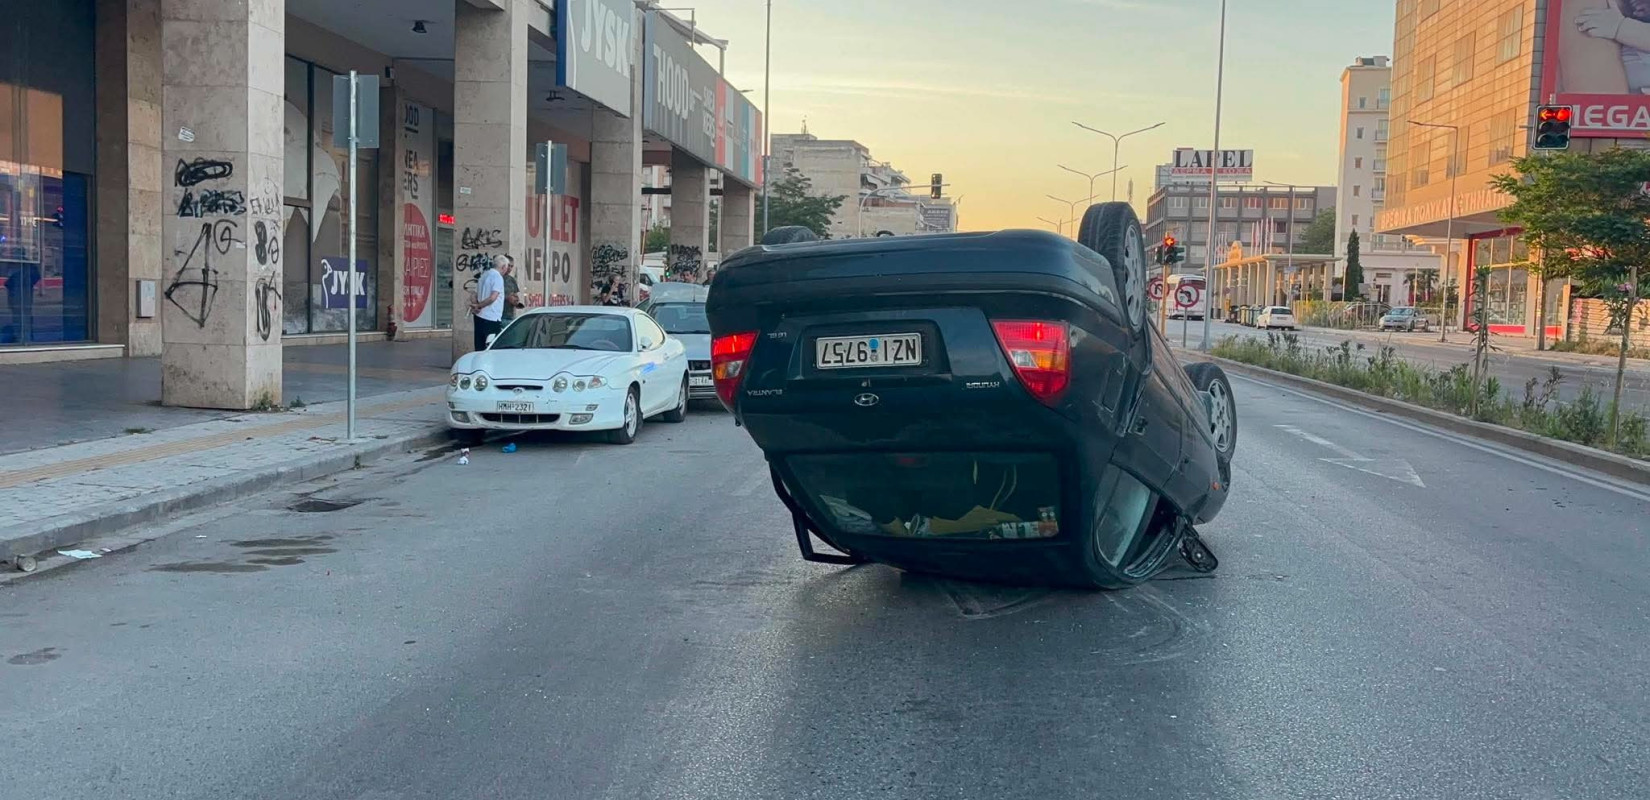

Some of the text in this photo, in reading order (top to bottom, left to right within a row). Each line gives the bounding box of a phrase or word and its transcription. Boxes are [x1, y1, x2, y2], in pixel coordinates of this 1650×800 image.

[581, 0, 630, 78] JYSK
[653, 43, 689, 119] HOOD
[1175, 150, 1252, 168] LAPEL
[526, 194, 580, 244] ULET
[331, 270, 365, 295] JYK
[821, 338, 917, 365] NZI 9757
[746, 389, 783, 397] ELANTRA
